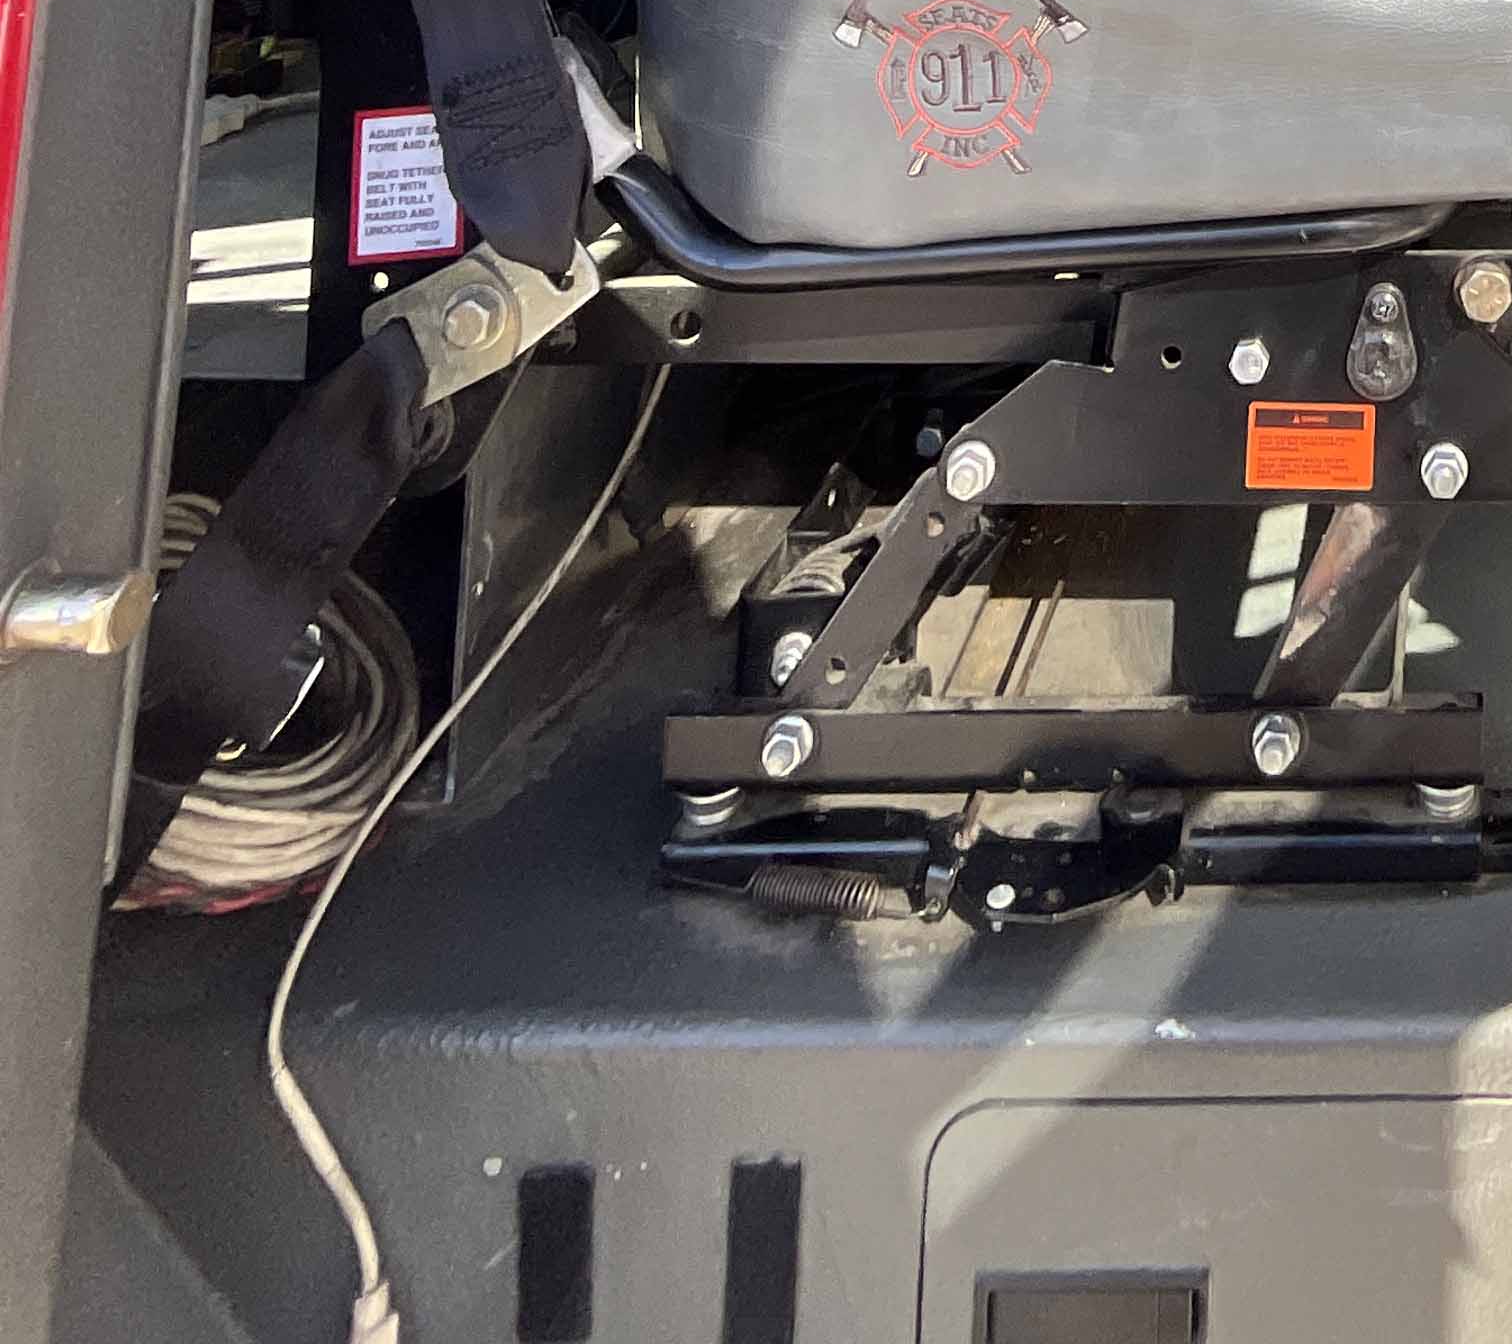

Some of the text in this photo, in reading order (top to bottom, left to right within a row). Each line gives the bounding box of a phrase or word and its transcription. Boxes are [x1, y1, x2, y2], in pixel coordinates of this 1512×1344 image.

[920, 43, 1007, 112] 911
[402, 140, 426, 150] AND
[940, 135, 988, 158] INC
[400, 181, 427, 192] WITH
[365, 194, 434, 209] SEAT FULLY
[410, 208, 434, 219] AND
[364, 221, 440, 237] UNOCCUPIED
